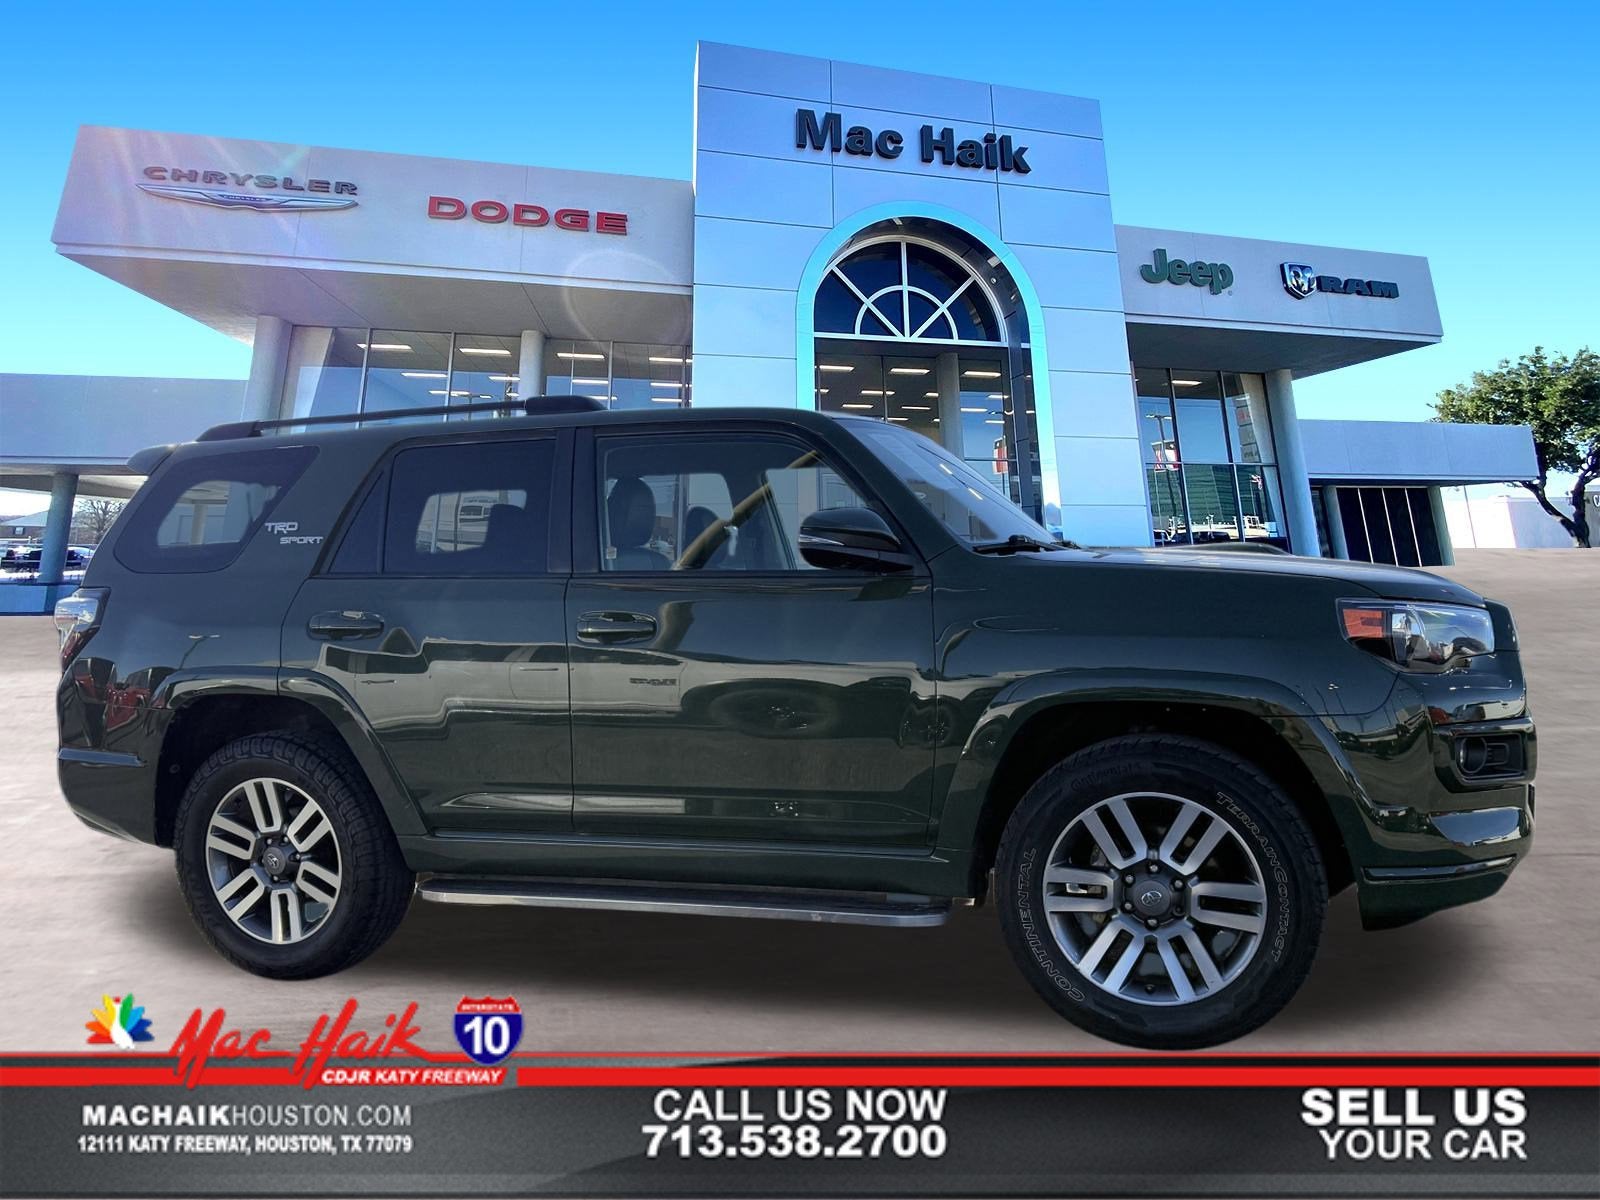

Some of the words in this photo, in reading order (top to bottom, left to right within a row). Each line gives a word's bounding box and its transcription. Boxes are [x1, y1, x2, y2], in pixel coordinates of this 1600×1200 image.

[796, 108, 904, 160] Mac
[920, 125, 1032, 174] Haik
[143, 166, 359, 196] CHRYSLER
[428, 196, 628, 236] DODGE
[1140, 248, 1234, 296] Jeep
[1316, 275, 1400, 299] RAM
[265, 522, 298, 534] TRD
[280, 536, 324, 545] SPORT
[1017, 848, 1086, 1002] CONTINENTAL
